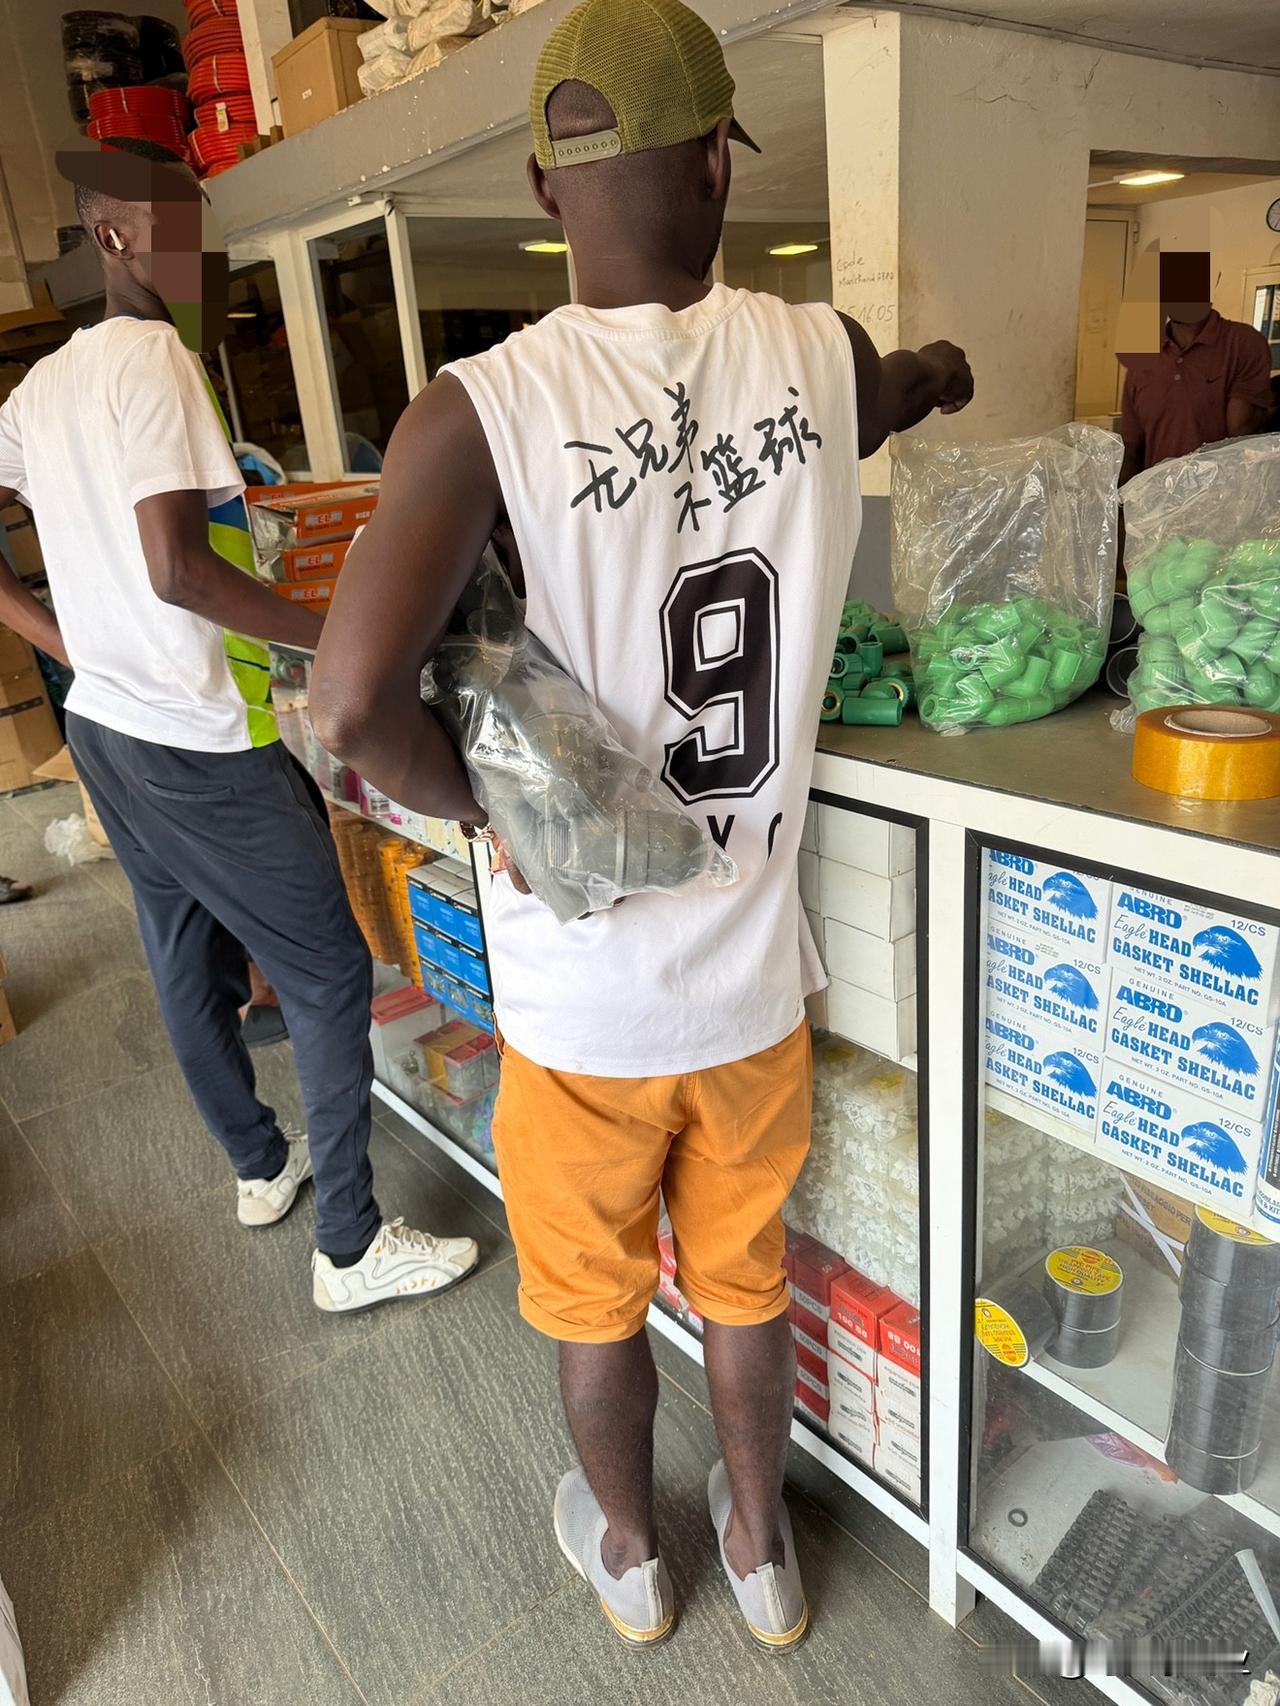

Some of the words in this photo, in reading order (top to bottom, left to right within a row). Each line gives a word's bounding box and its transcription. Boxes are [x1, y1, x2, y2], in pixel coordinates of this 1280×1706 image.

[659, 546, 781, 806] 9
[1009, 876, 1043, 902] HEAD
[987, 888, 1029, 916] ASKET
[1033, 907, 1096, 943] SHELLAC
[1117, 892, 1182, 929] ABRO
[1230, 919, 1266, 937] 12/CS
[990, 926, 1026, 945] GENUINE
[1113, 914, 1147, 940] Eagle
[1149, 929, 1192, 958] HEAD
[986, 959, 1008, 974] agle
[1008, 964, 1043, 990] HEAD
[1073, 959, 1101, 975] 12/CS
[1113, 937, 1174, 973] GASKET
[1179, 963, 1260, 1006] SHELLAC
[986, 975, 1029, 1003] ASKET
[1033, 995, 1098, 1033] SHELLAC
[1116, 985, 1183, 1024] ABRO
[1129, 978, 1174, 1001] GENUINE
[985, 1018, 1035, 1051] ABRO
[990, 1011, 1027, 1030] GENUINE
[1112, 1006, 1146, 1032] Eagle
[1147, 1021, 1191, 1051] HEAD
[1230, 1017, 1264, 1036] 12/CS
[985, 1040, 1007, 1056] agle
[1008, 1049, 1042, 1075] HEAD
[1073, 1047, 1100, 1064] 12/CS
[1111, 1028, 1172, 1065] GASKET
[1177, 1057, 1256, 1100] SHELLAC
[986, 1057, 1028, 1086] ASKET
[1032, 1079, 1095, 1119] SHELLAC
[1106, 1080, 1172, 1121] ABRO
[1118, 1074, 1164, 1099] GENUINE
[1103, 1101, 1137, 1126] Eagle
[1137, 1117, 1180, 1147] HEAD
[1219, 1117, 1252, 1137] 12/CS
[1102, 1121, 1162, 1160] GASKET
[1167, 1151, 1244, 1198] SHELLAC
